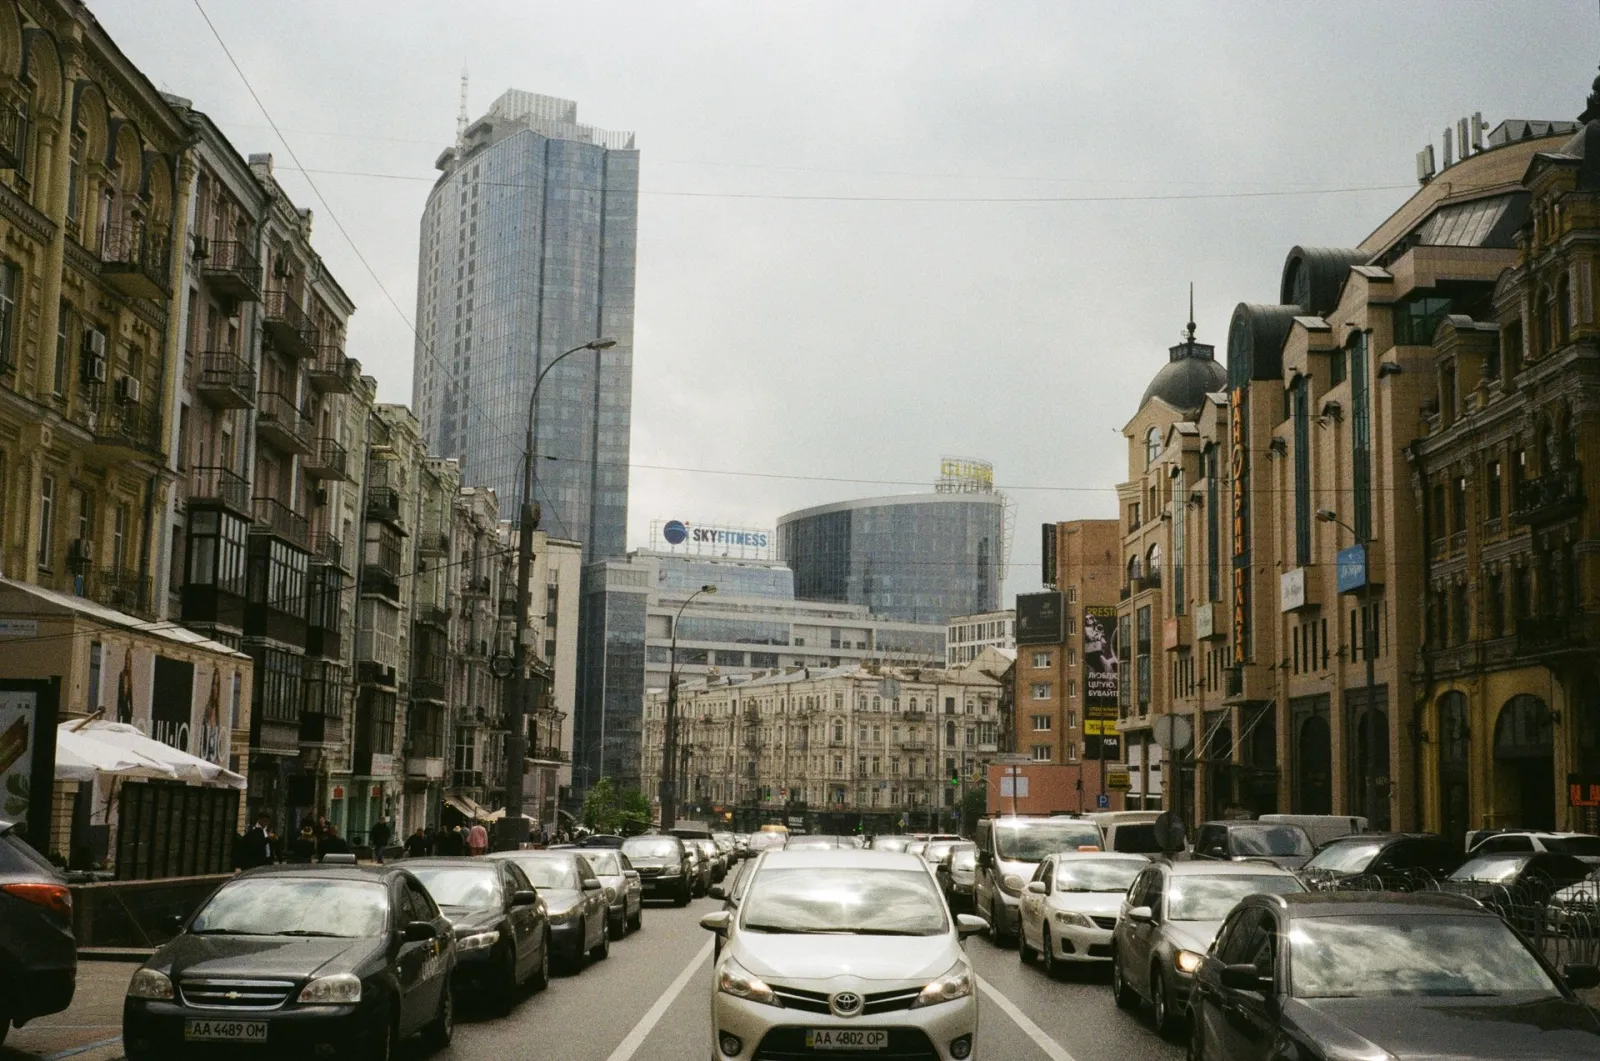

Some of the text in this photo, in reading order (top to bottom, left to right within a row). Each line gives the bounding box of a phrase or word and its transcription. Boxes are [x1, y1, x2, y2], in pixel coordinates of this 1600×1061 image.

[1234, 567, 1245, 662] ПЛАЗА
[192, 1022, 266, 1037] AA 4489 OM
[814, 1031, 885, 1045] AA 4802 OP
